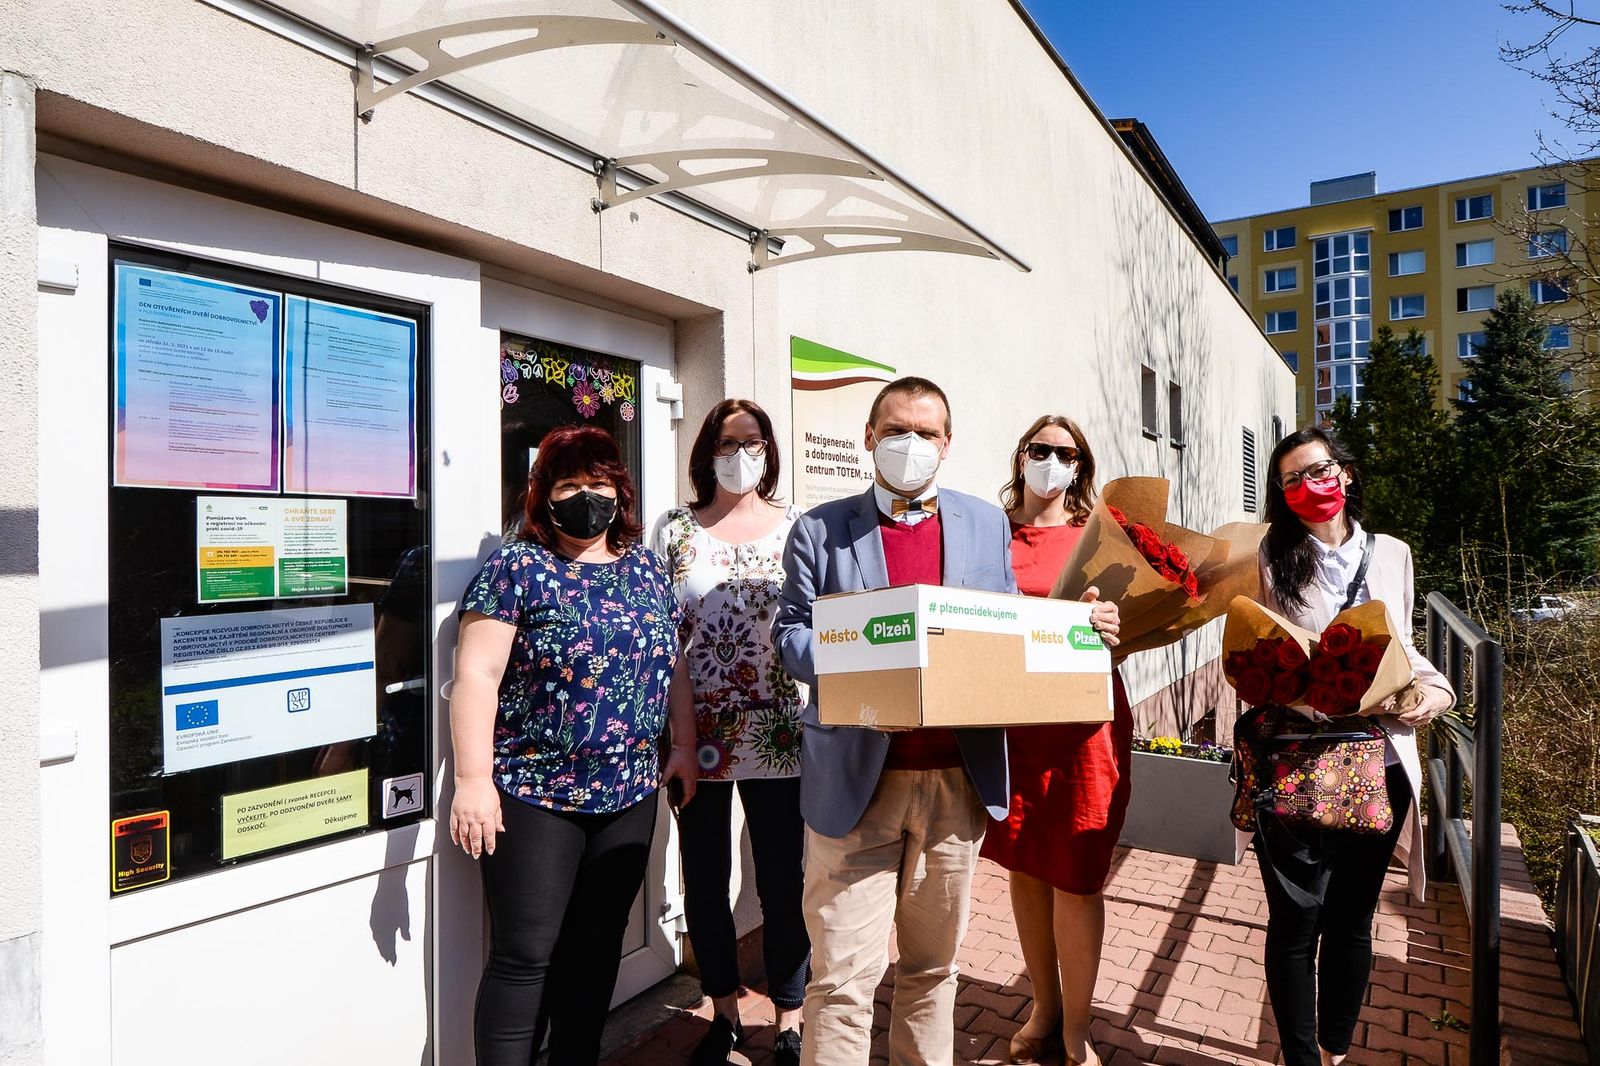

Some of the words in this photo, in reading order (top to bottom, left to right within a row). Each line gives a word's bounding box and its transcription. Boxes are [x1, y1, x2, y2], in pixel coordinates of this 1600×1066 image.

[152, 304, 191, 314] OTEVŘENÝCH
[210, 314, 258, 326] DOBROVOLNICTVÍ
[805, 432, 855, 449] Mezigenerační
[805, 449, 810, 458] a
[812, 449, 859, 464] dobrovolnické
[805, 465, 835, 475] centrum
[836, 466, 863, 480] TOTEM,
[864, 472, 874, 480] z.s.
[928, 602, 936, 612] #
[240, 621, 290, 631] DOBROVOLNICTVÍ
[820, 628, 858, 644] Město
[873, 619, 911, 639] Plzeň
[173, 636, 208, 644] AKCENTEM
[250, 629, 283, 637] REGIONÁLNÍ
[1031, 629, 1064, 644] Město
[174, 641, 228, 651] DOBROVOLNICTVÍ
[174, 649, 215, 658] REGISTRAČNÍ
[176, 731, 207, 740] EVROPSKÁ
[176, 743, 199, 752] Operační
[247, 798, 283, 811] ZAZVONĚNÍ
[288, 795, 309, 804] zvonek
[310, 788, 337, 799] RECEPCE)
[237, 813, 268, 824] VYČKEJTE,
[280, 801, 316, 815] ODZVONĚNÍ
[317, 798, 335, 807] DVEŘE
[336, 794, 353, 803] SAMY
[324, 812, 357, 825] Děkujeme
[237, 821, 267, 834] ODSKOČÍ.
[118, 869, 134, 877] High
[136, 863, 165, 873] Security
